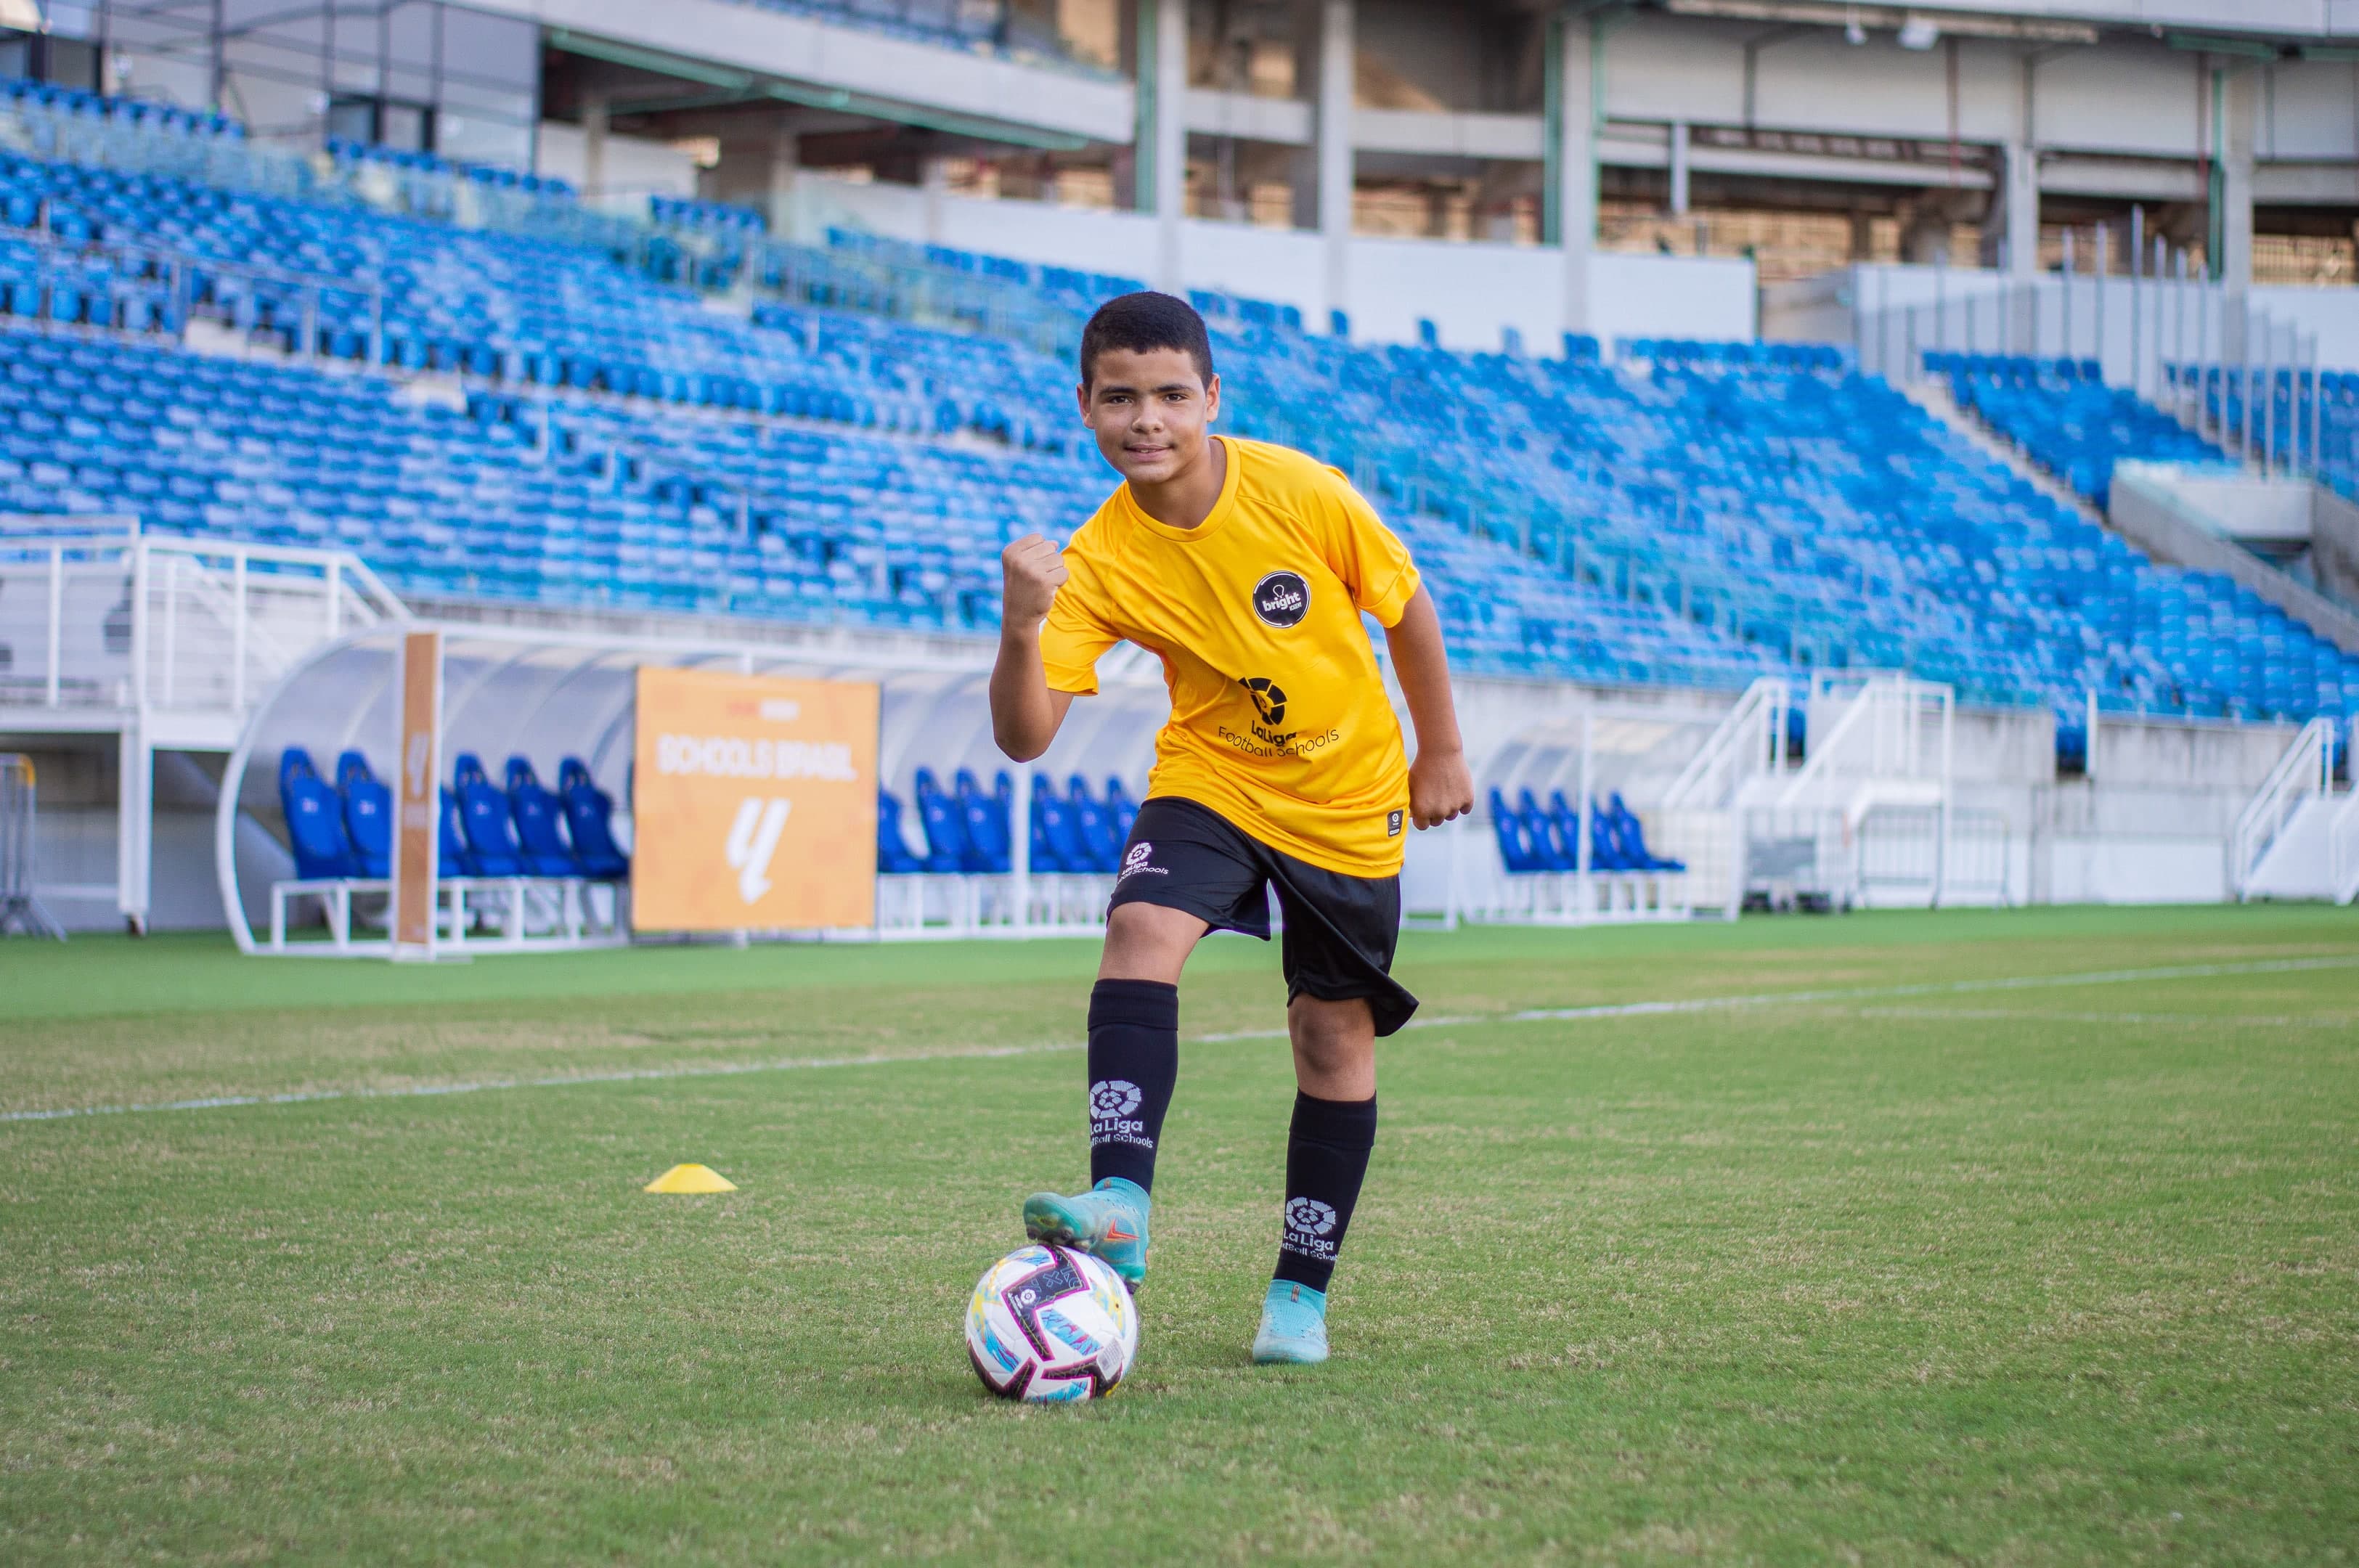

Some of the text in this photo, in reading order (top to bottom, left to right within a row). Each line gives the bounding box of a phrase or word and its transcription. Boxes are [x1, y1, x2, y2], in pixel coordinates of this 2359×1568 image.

[1262, 592, 1301, 612] bright
[1218, 726, 1340, 757] Football Schools
[1251, 719, 1297, 747] LaLiga
[1132, 866, 1170, 875] Schools
[1113, 1133, 1154, 1148] Schools
